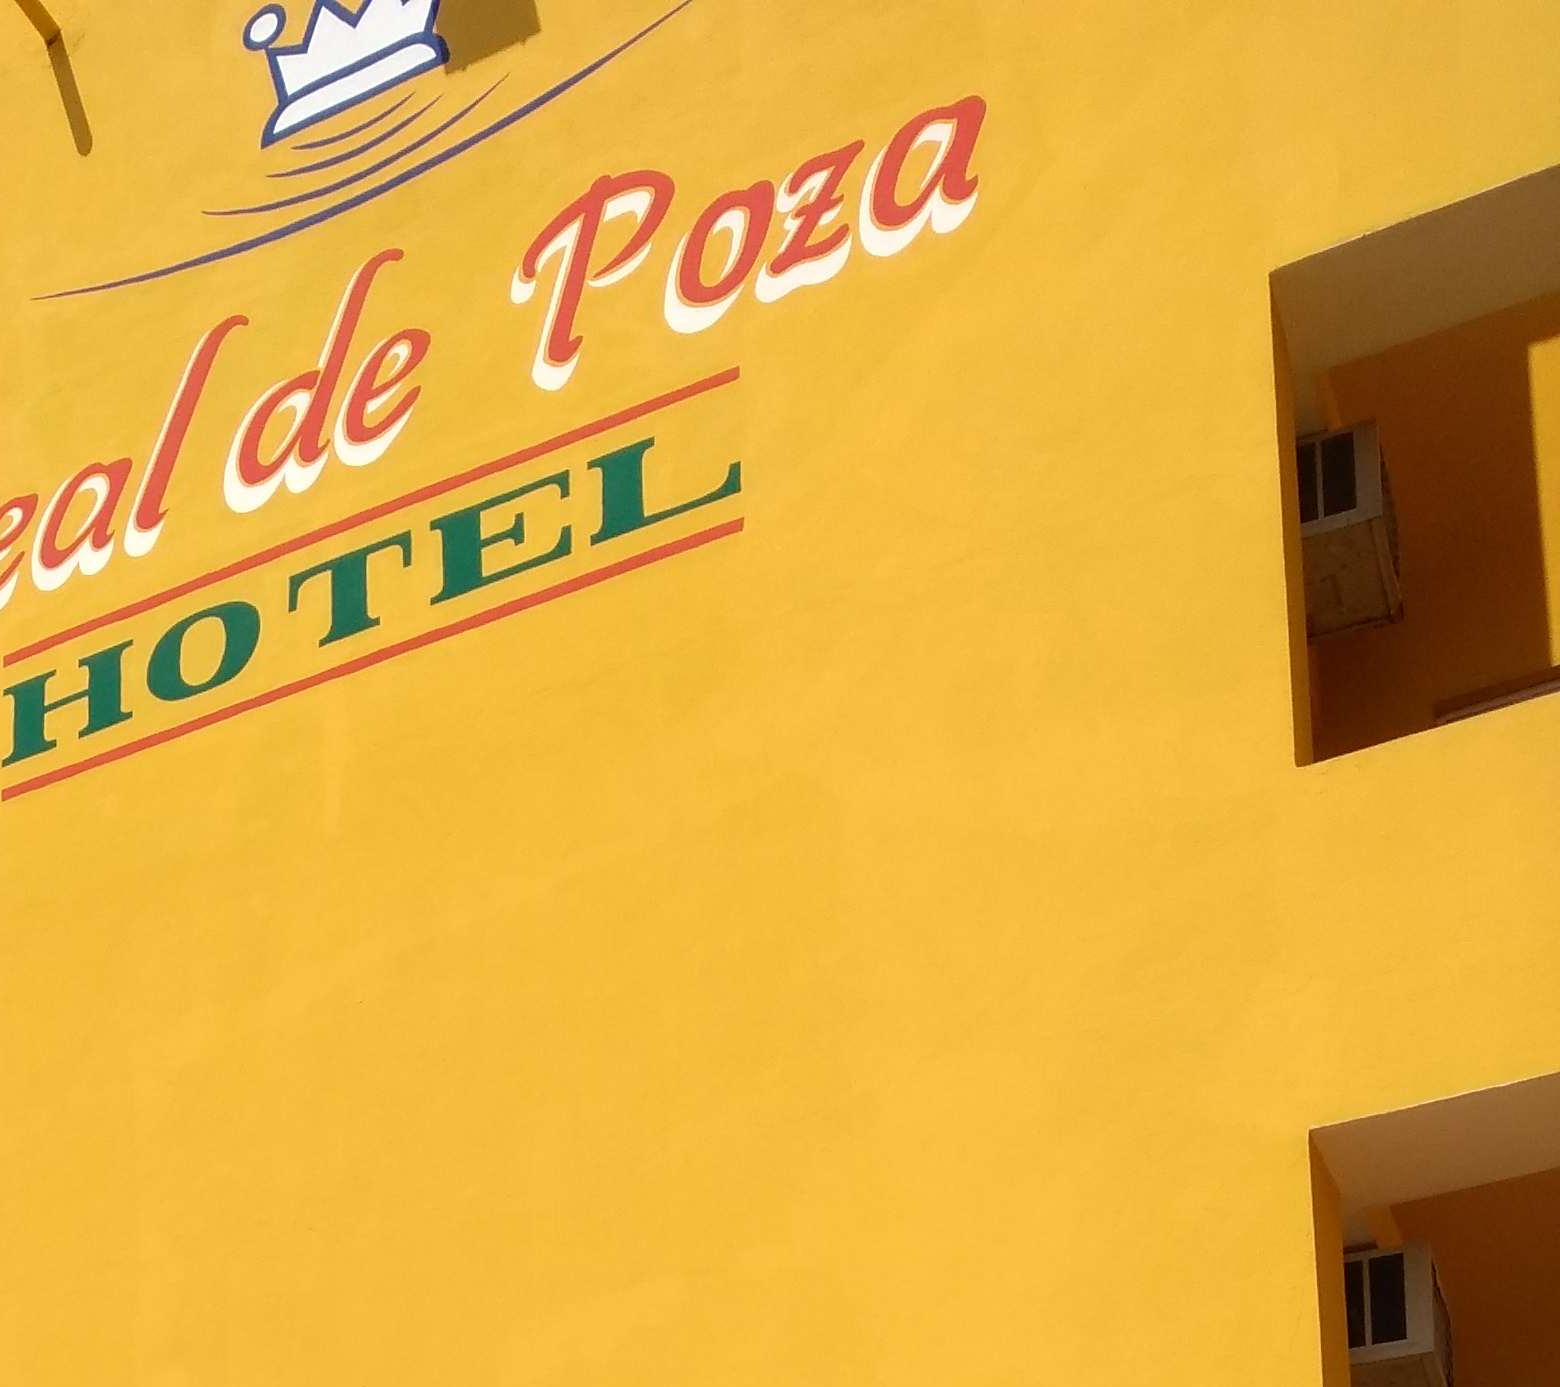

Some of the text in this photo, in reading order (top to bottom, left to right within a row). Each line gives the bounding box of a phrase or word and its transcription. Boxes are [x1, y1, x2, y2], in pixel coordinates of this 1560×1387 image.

[225, 248, 431, 513] de
[511, 94, 987, 391] Poza
[1, 437, 742, 768] HOTEL
